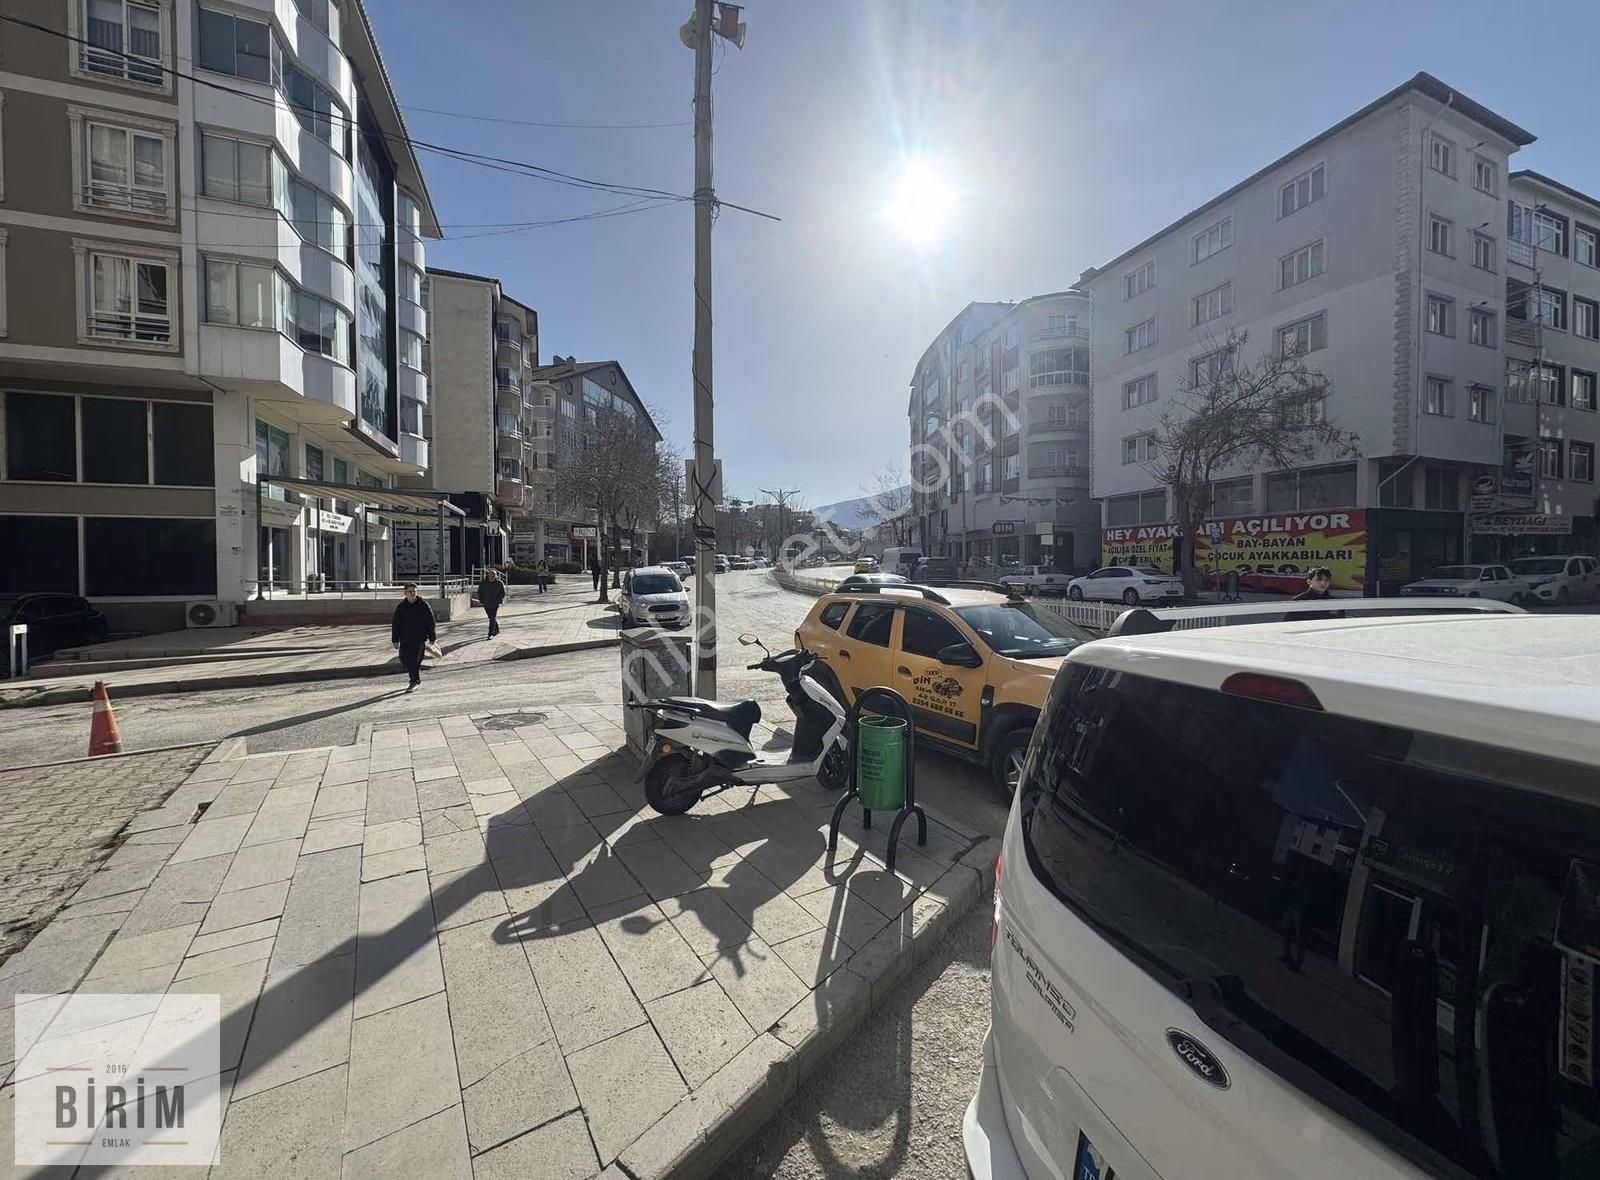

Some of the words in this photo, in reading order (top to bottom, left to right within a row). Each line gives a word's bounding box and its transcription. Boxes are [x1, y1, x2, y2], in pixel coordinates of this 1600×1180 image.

[1106, 529, 1134, 541] HEY
[1232, 513, 1351, 536] AÇILIYOR
[1236, 537, 1306, 549] BAY-BAYAN
[1207, 551, 1244, 562] ÇOCUK
[1249, 550, 1353, 561] AYAKKABILARI
[1005, 925, 1077, 1020] TOURNEO
[1025, 972, 1075, 1034] COURIER
[1177, 1039, 1213, 1076] Ford
